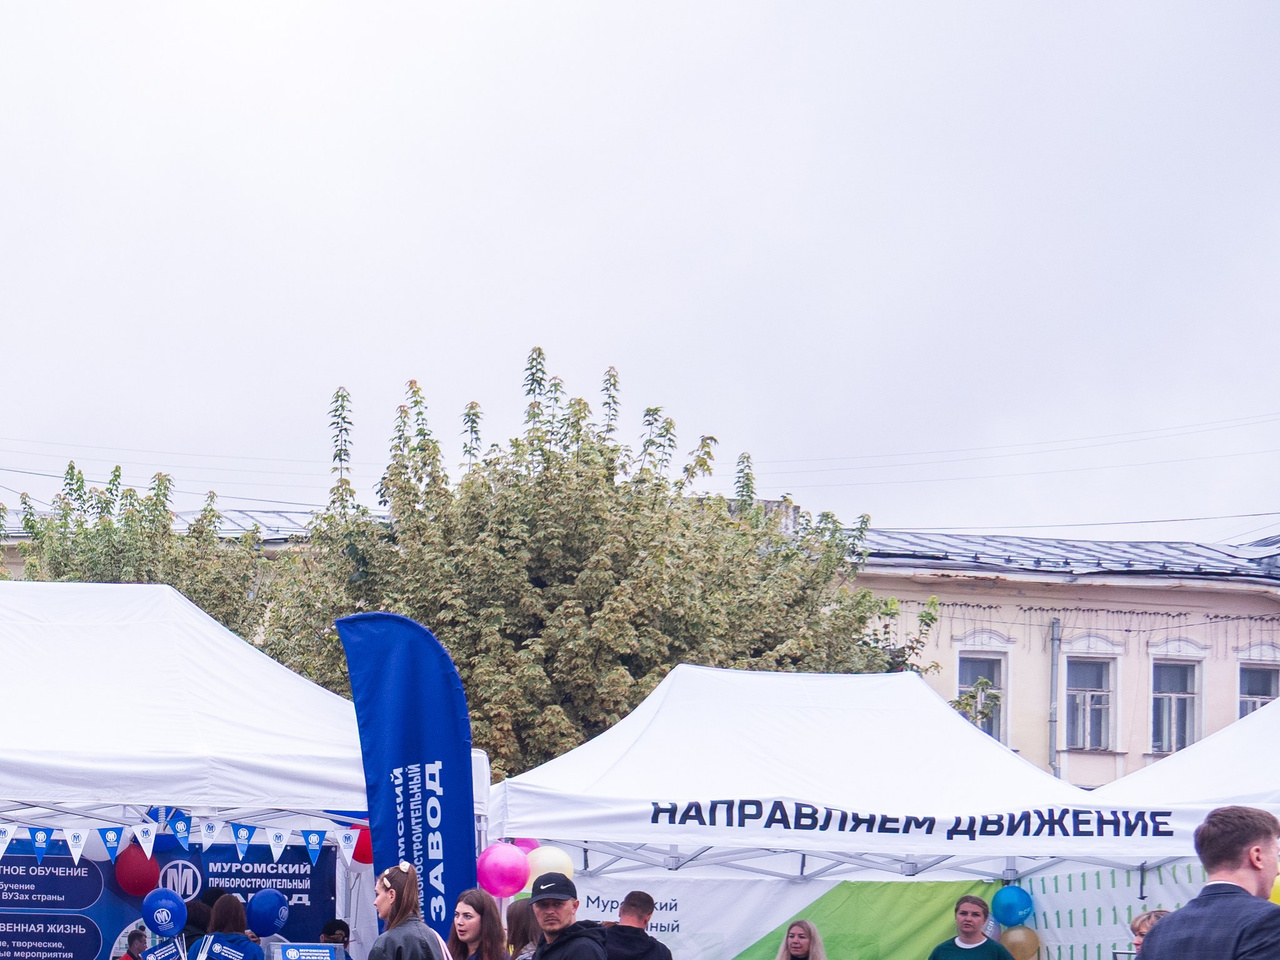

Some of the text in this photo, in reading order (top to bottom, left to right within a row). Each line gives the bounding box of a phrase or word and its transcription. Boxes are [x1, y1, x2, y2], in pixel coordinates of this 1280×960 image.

[390, 767, 405, 863] МСКИЙ
[651, 799, 1175, 841] НАПРАВЛЯЕМ ДВИЖЕНИЕ
[425, 760, 447, 922] ЗАВОД
[29, 866, 89, 877] ОБУЧЕНИЕ
[209, 862, 311, 875] МУРОМСКИЙ
[208, 877, 311, 889] ПРИБОРОСТРОИТЕЛЬНЫЙ
[1, 892, 30, 901] ВУЗах
[31, 894, 65, 902] страны
[586, 895, 678, 913] Муркий
[47, 923, 86, 934] ЖИЗНЬ
[12, 940, 65, 949] творческие,
[14, 951, 74, 959] мероприятия
